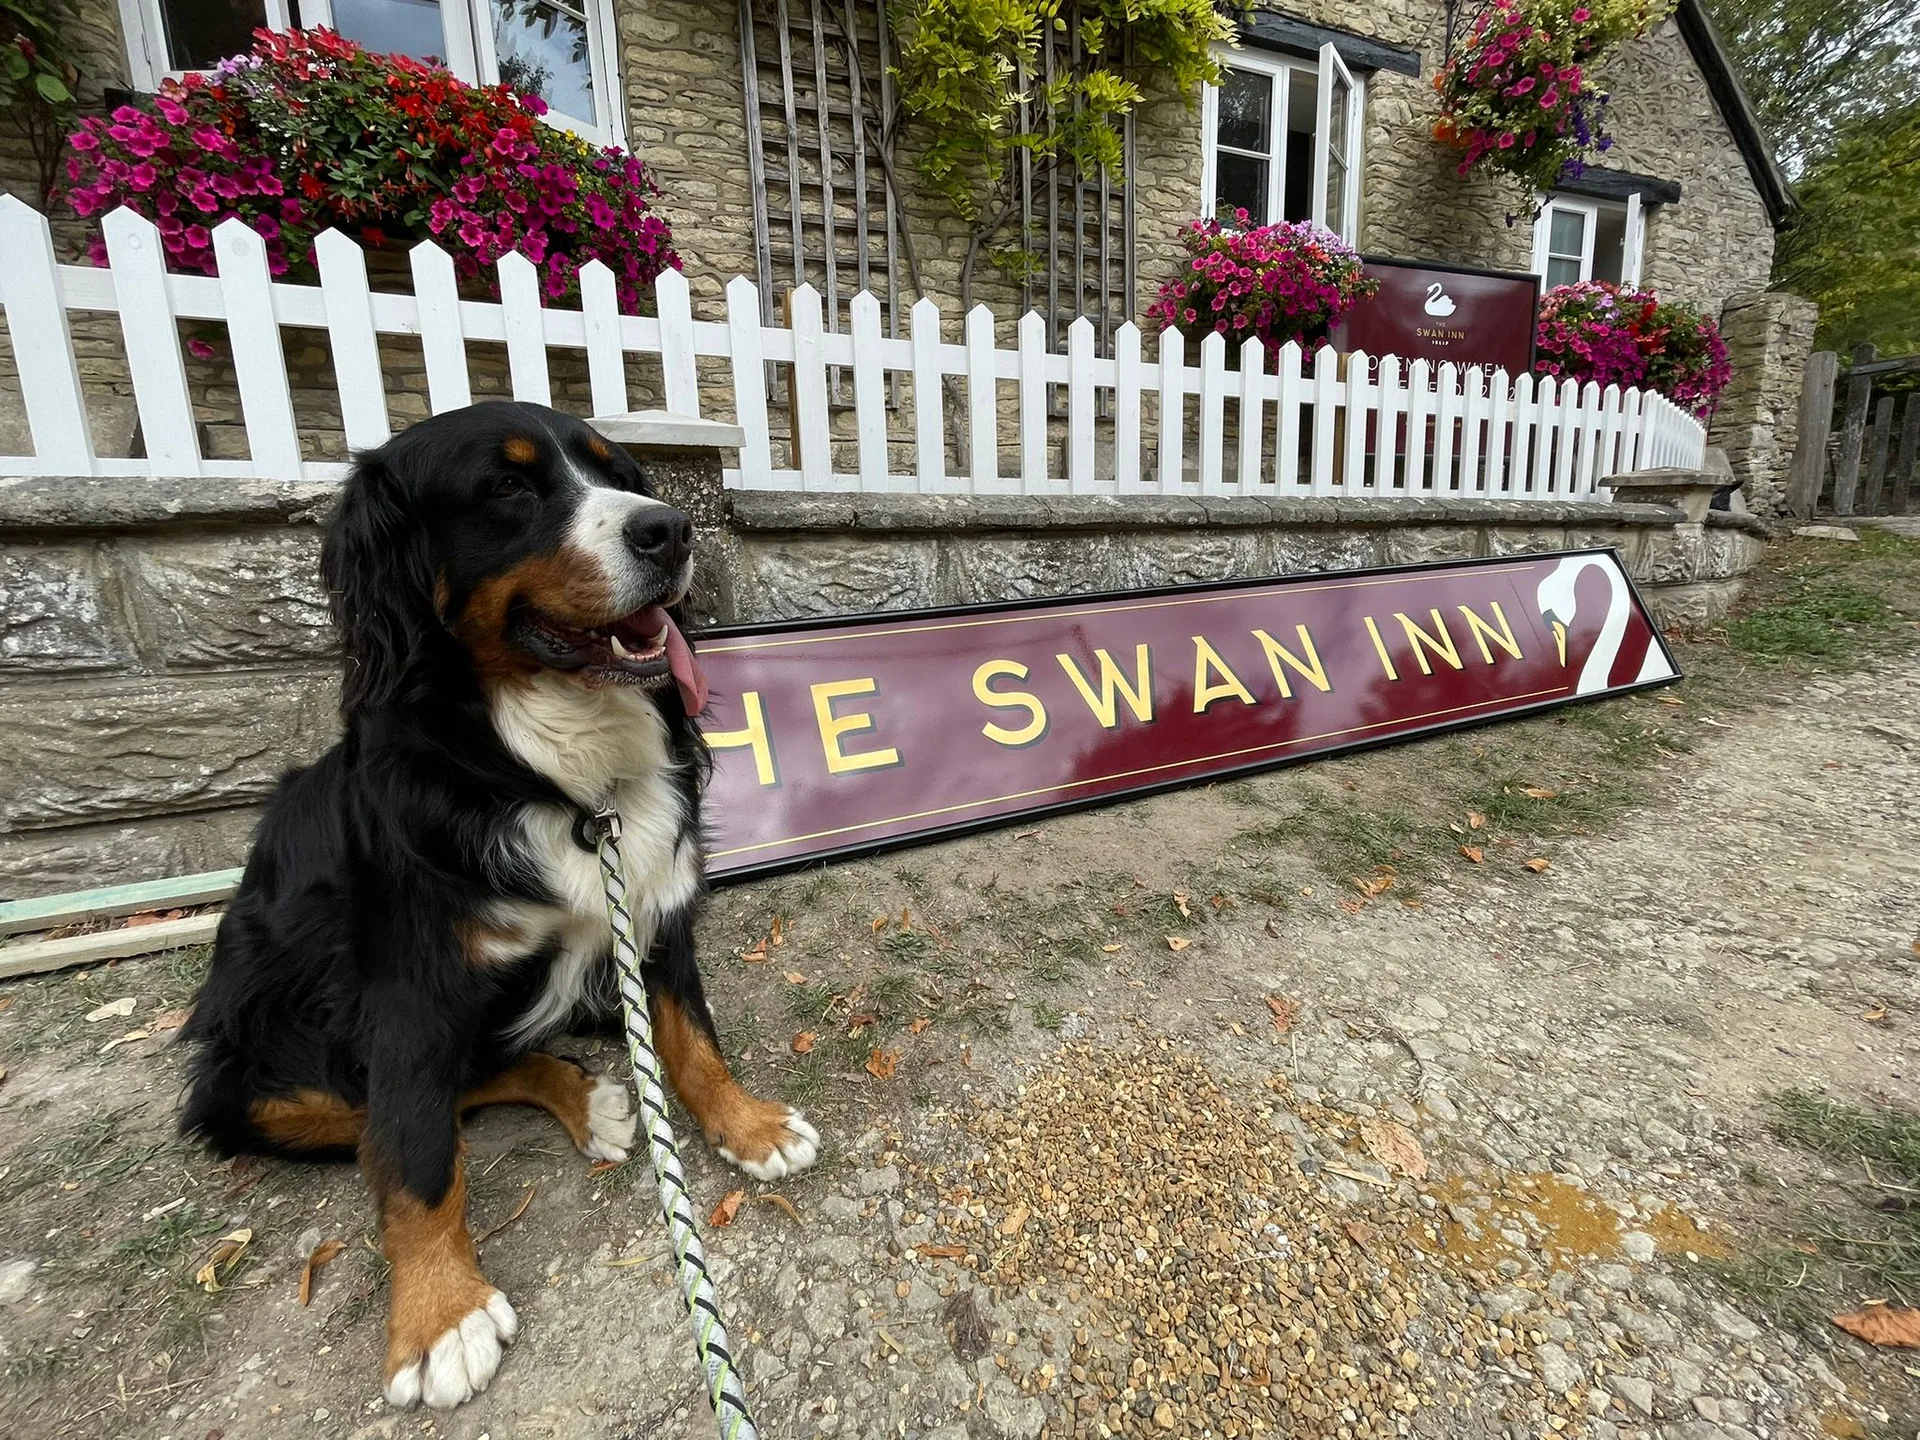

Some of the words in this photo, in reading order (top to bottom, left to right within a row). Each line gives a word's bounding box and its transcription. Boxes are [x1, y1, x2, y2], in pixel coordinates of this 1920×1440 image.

[1416, 327, 1444, 338] SWAN
[1447, 330, 1465, 340] INN
[1457, 361, 1505, 378] WEN
[701, 677, 903, 787] HE
[972, 624, 1331, 747] SWAN
[1363, 601, 1524, 681] INN
